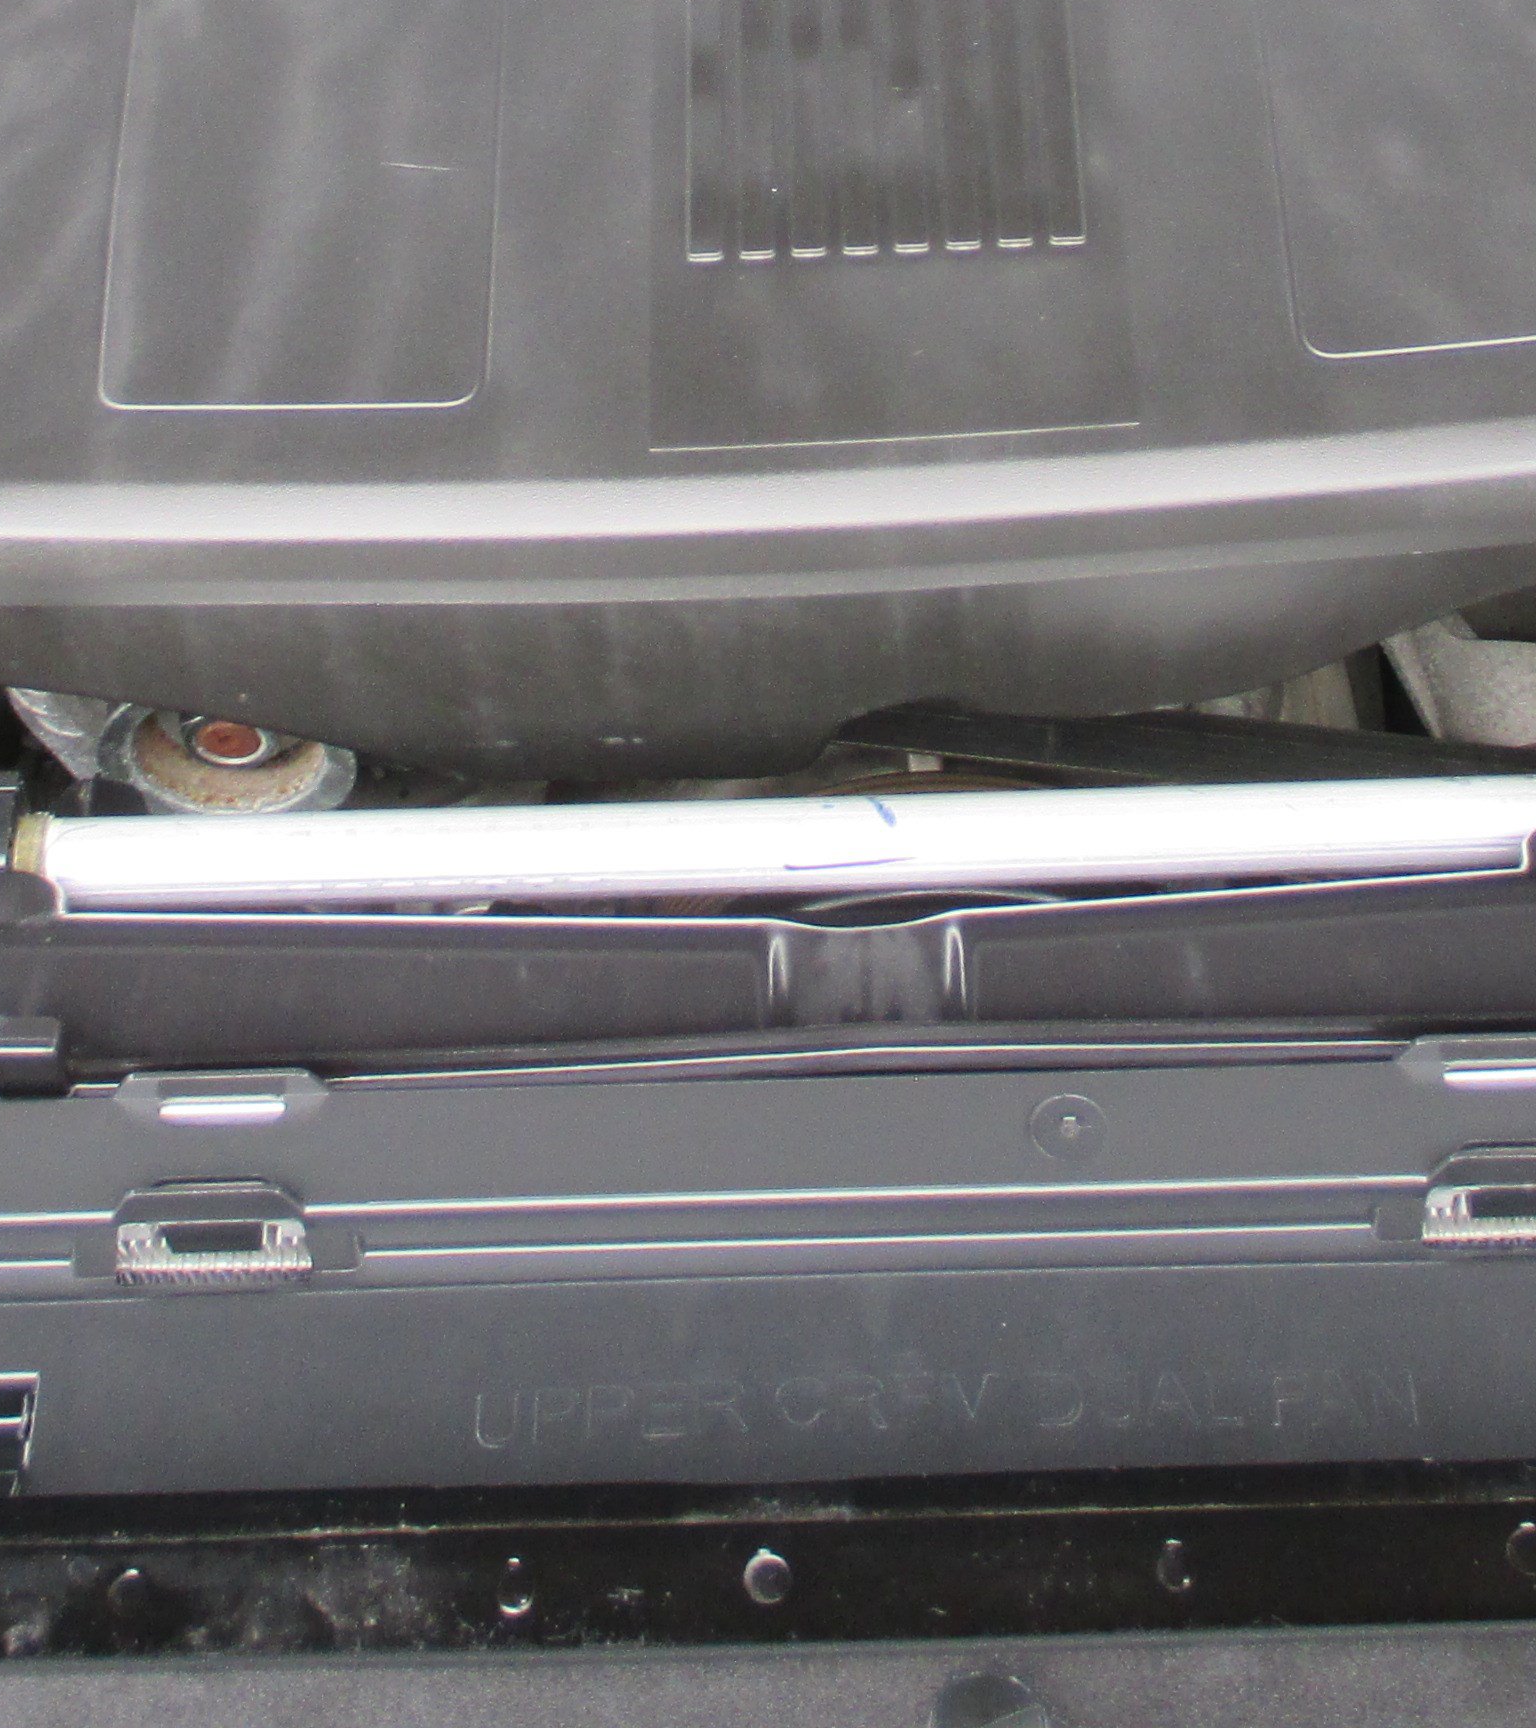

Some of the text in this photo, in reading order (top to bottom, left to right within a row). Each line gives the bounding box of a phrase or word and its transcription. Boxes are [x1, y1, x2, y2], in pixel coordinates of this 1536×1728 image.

[472, 1375, 751, 1450] UPPER
[1026, 1368, 1246, 1430] DUAL
[1270, 1367, 1422, 1431] FAN
